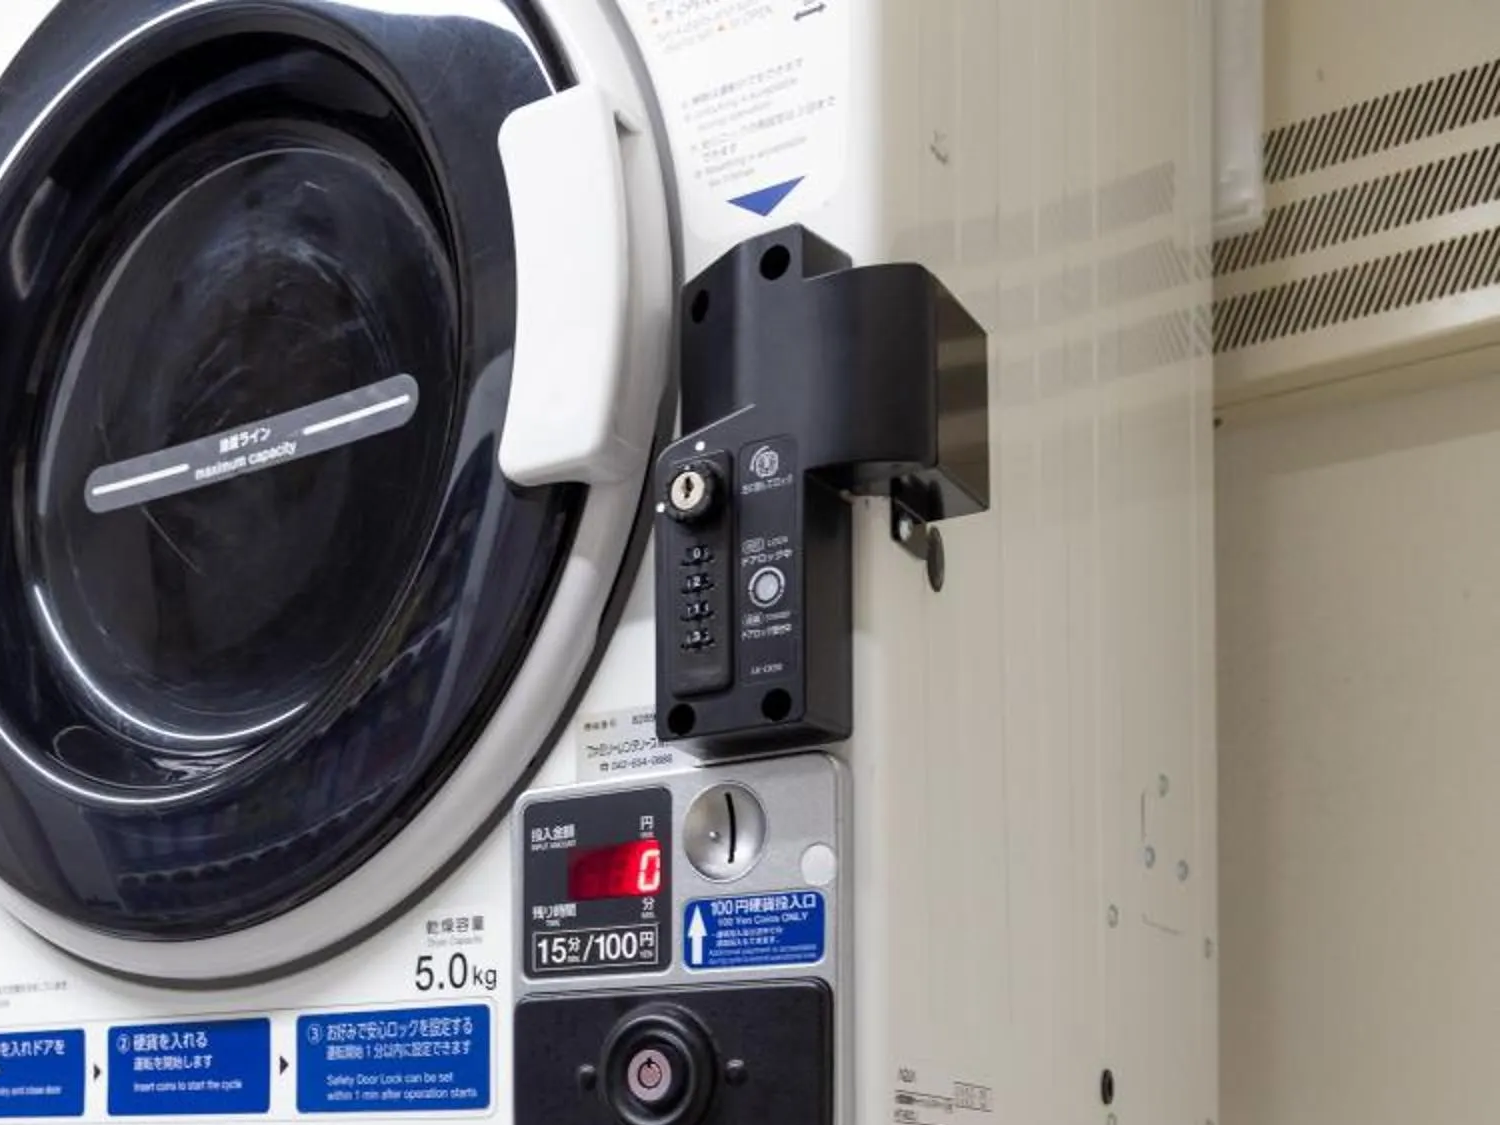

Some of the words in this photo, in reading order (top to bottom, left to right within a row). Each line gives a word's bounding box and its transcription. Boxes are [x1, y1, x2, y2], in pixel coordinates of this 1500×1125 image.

[195, 455, 247, 480] maximum
[247, 440, 297, 465] capacity
[640, 815, 654, 830] 円
[531, 824, 576, 842] 投入金額
[637, 849, 661, 892] 0
[642, 895, 656, 911] 分
[356, 1074, 379, 1085] Door
[380, 1073, 403, 1085] Lock
[403, 1087, 449, 1101] operation
